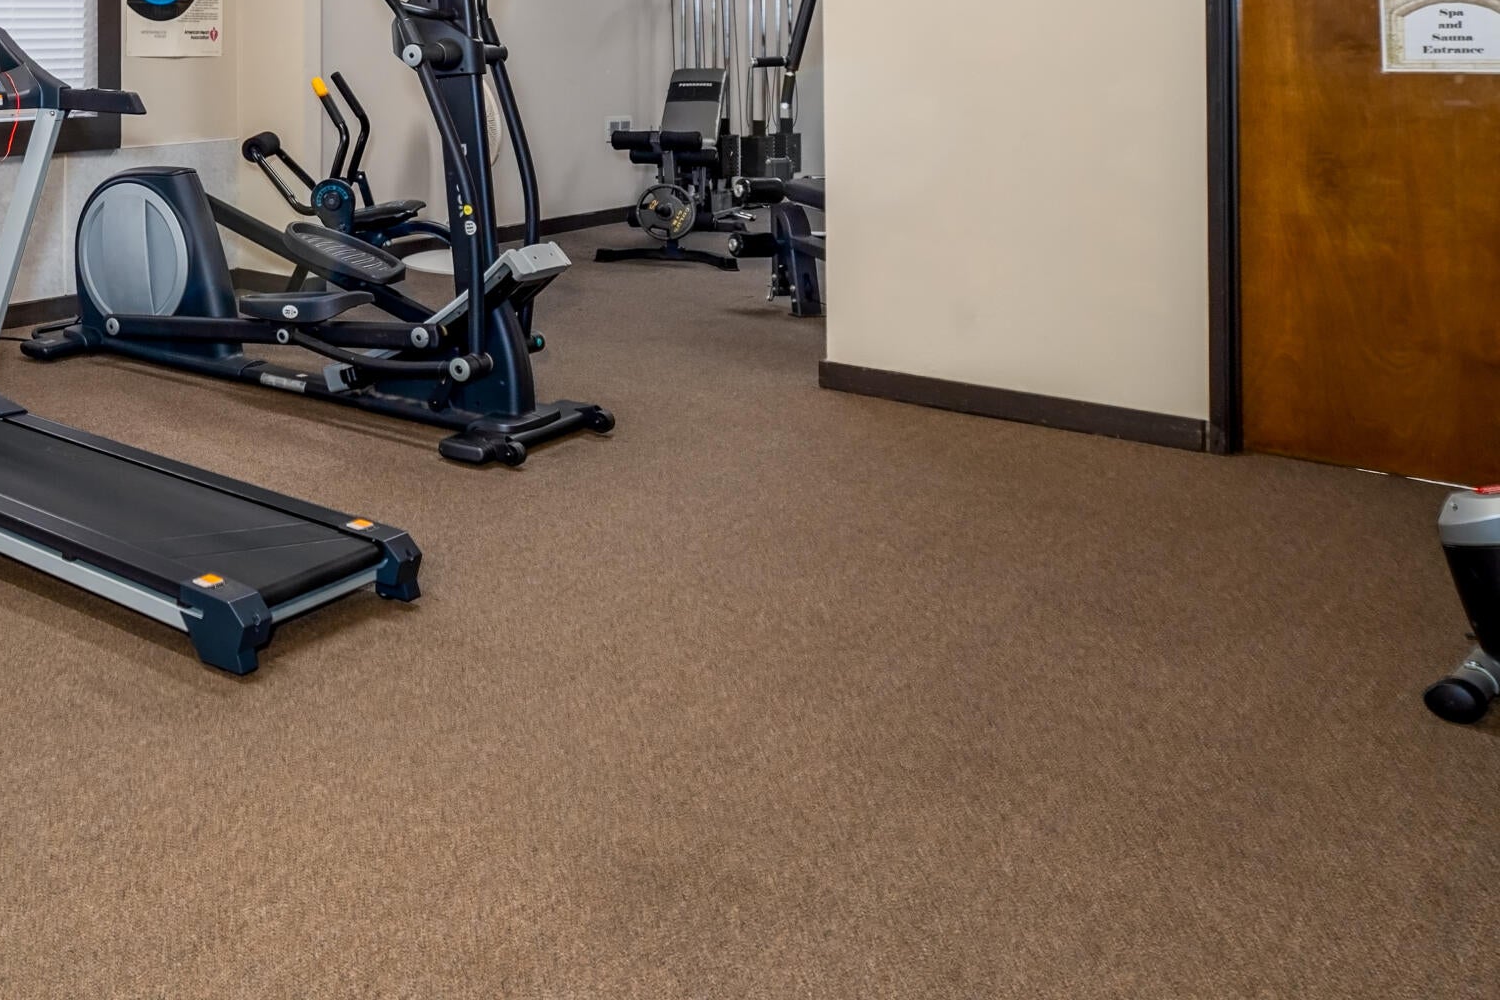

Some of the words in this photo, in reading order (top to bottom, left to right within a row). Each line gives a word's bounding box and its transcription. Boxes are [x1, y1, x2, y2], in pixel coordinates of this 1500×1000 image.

[1439, 8, 1464, 18] Spa
[1438, 20, 1462, 29] and
[1432, 33, 1473, 42] Sauna
[1422, 45, 1485, 55] Entrance
